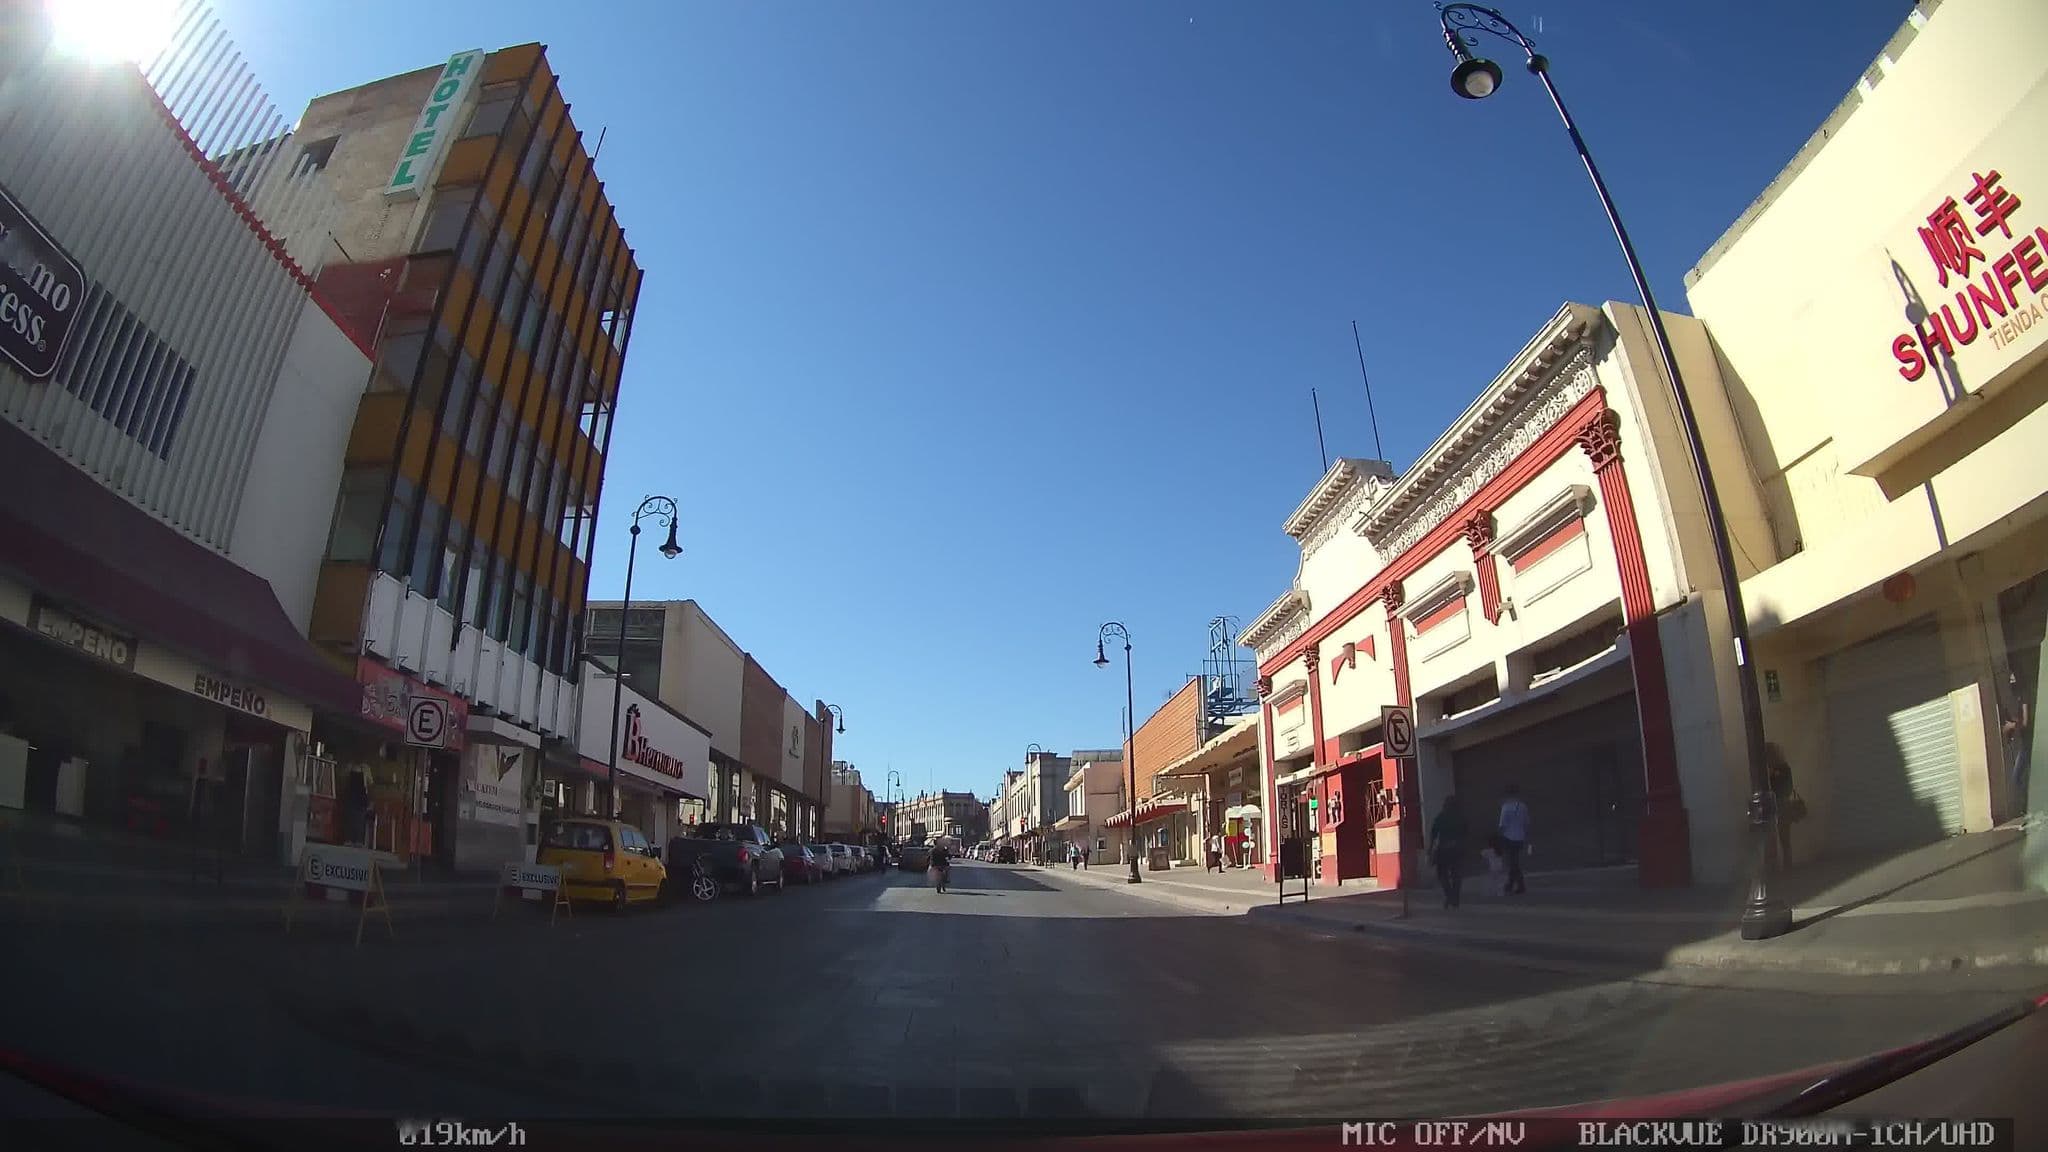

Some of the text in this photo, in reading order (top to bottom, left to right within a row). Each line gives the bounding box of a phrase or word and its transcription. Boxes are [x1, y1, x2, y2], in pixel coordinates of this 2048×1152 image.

[391, 55, 474, 187] HOTEL
[1917, 170, 2022, 288] 顺丰
[1988, 303, 2043, 350] TIENDA
[418, 709, 434, 734] E
[325, 864, 368, 881] EXCLUSIV
